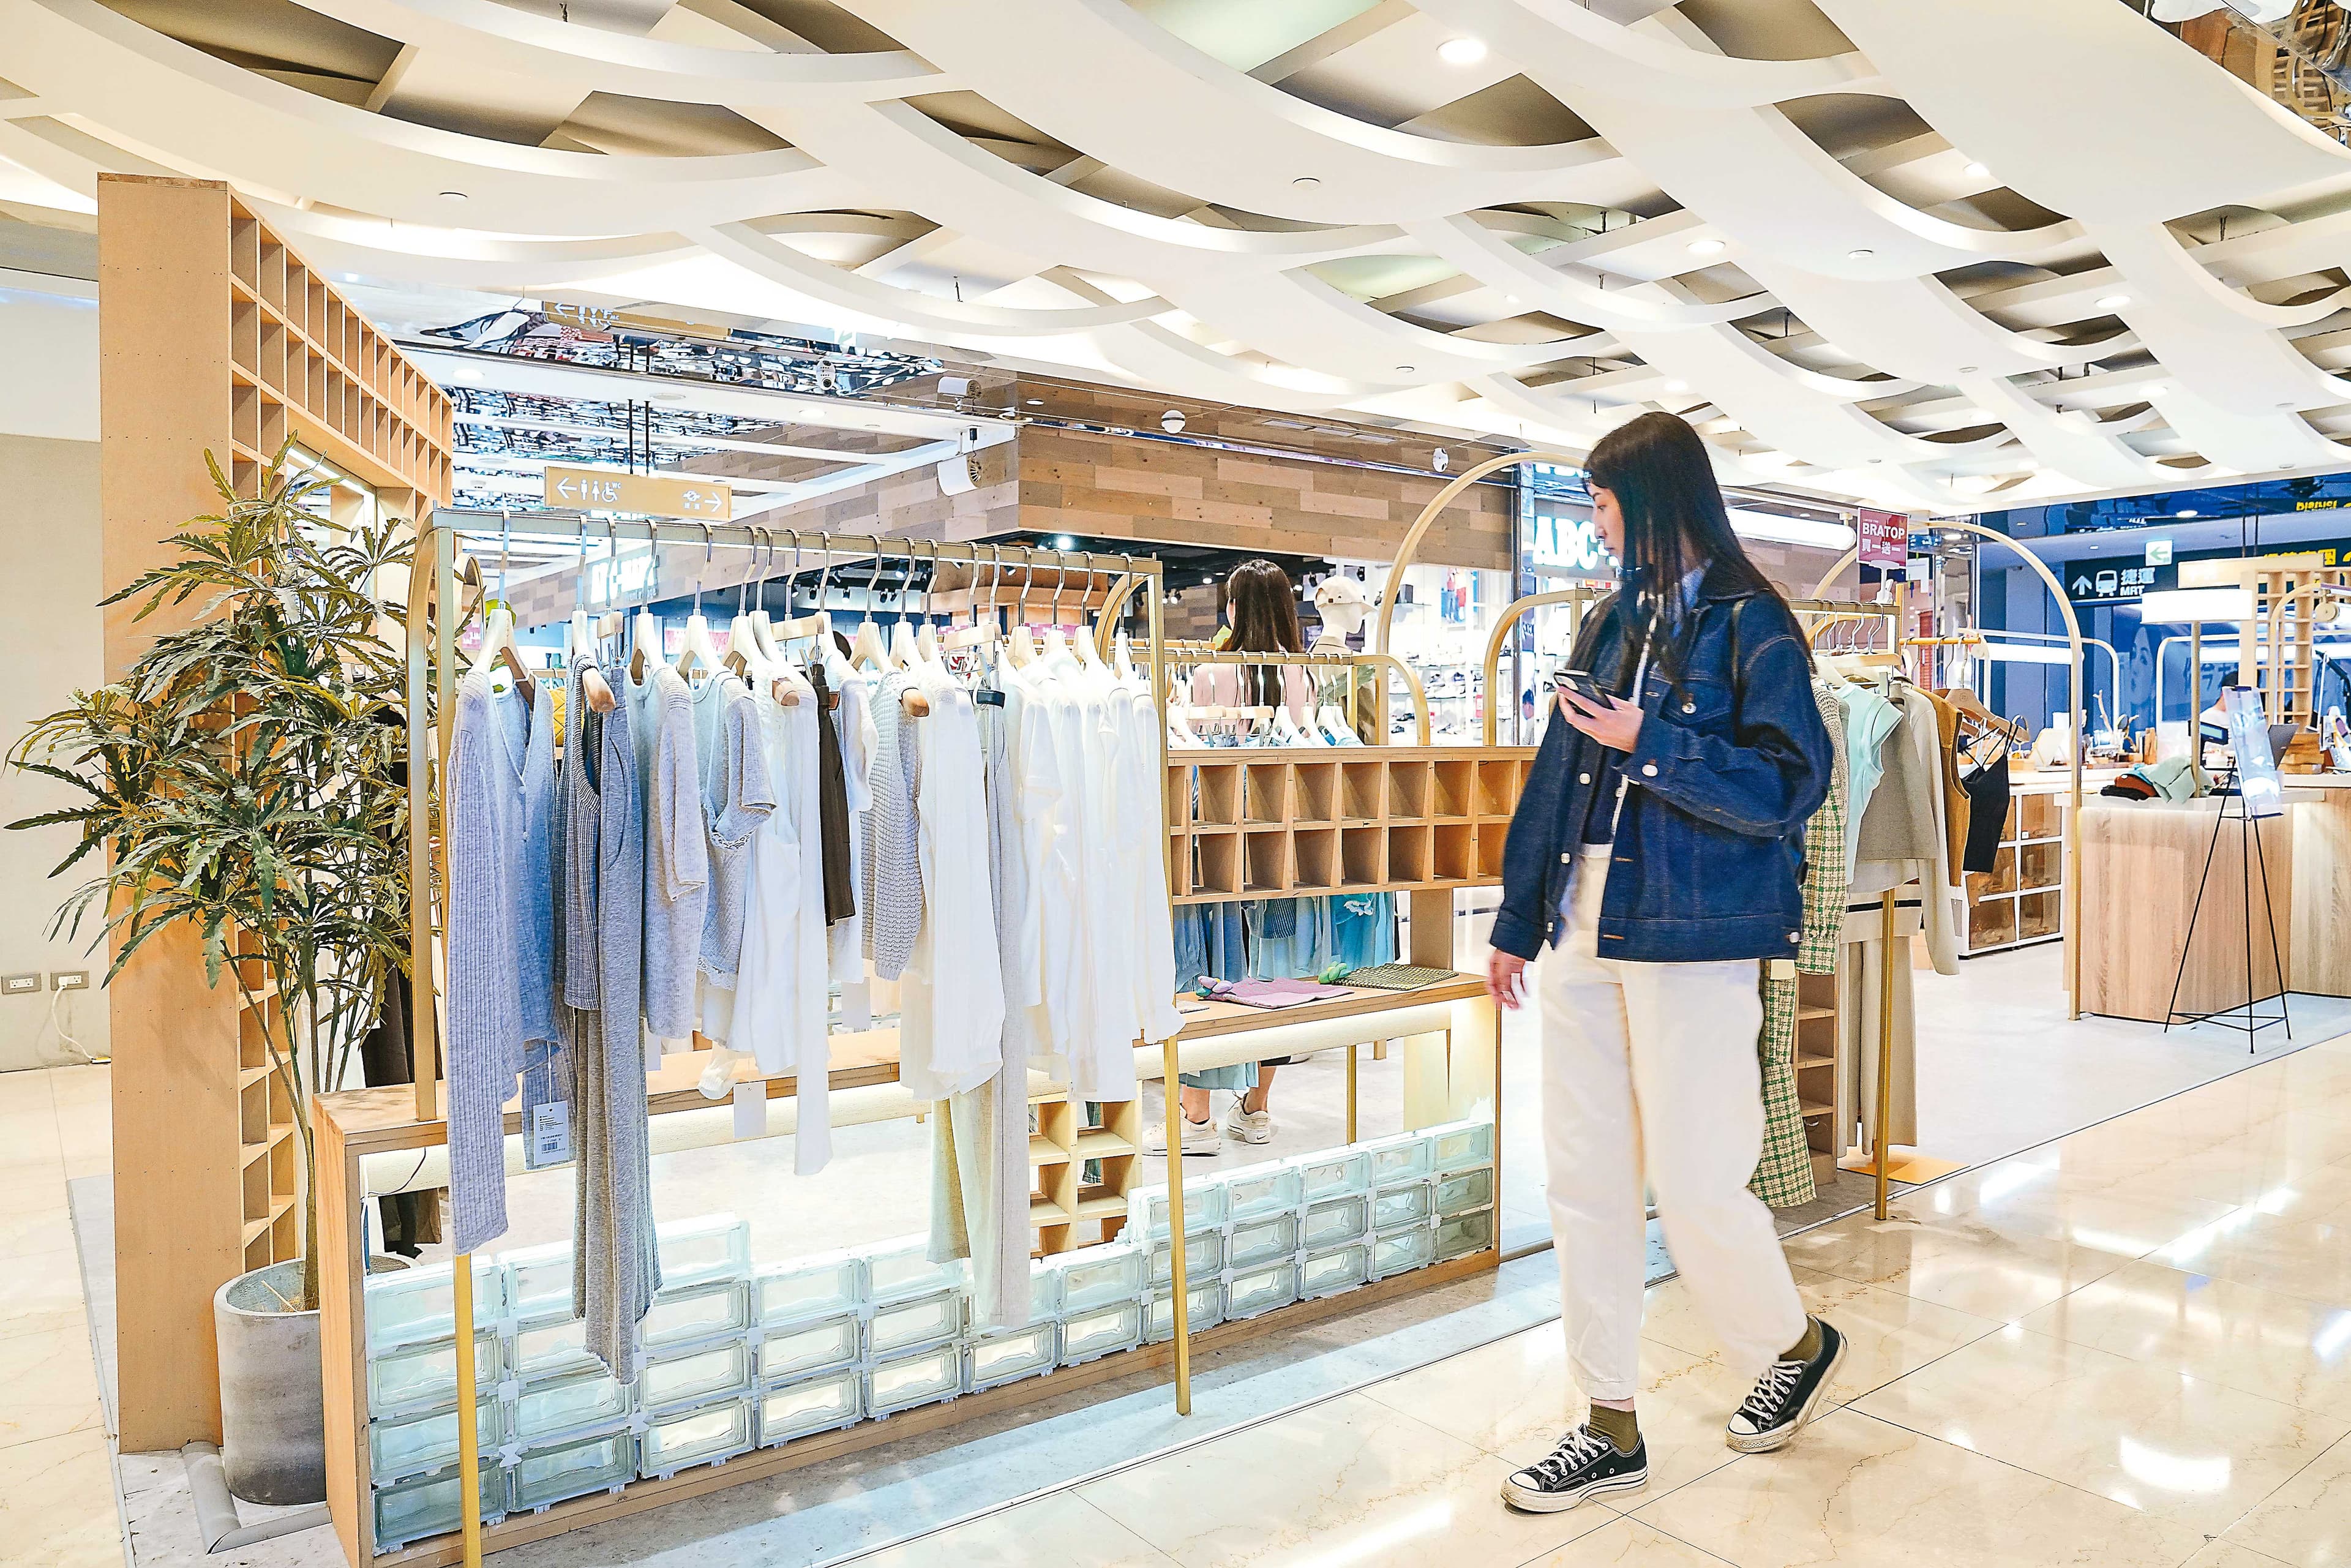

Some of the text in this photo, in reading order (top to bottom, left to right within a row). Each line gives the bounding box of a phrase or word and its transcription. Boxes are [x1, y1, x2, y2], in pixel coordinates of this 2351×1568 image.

[1862, 522, 1905, 540] BRATOP
[2121, 567, 2155, 585] 捷運
[2120, 586, 2145, 596] MRT
